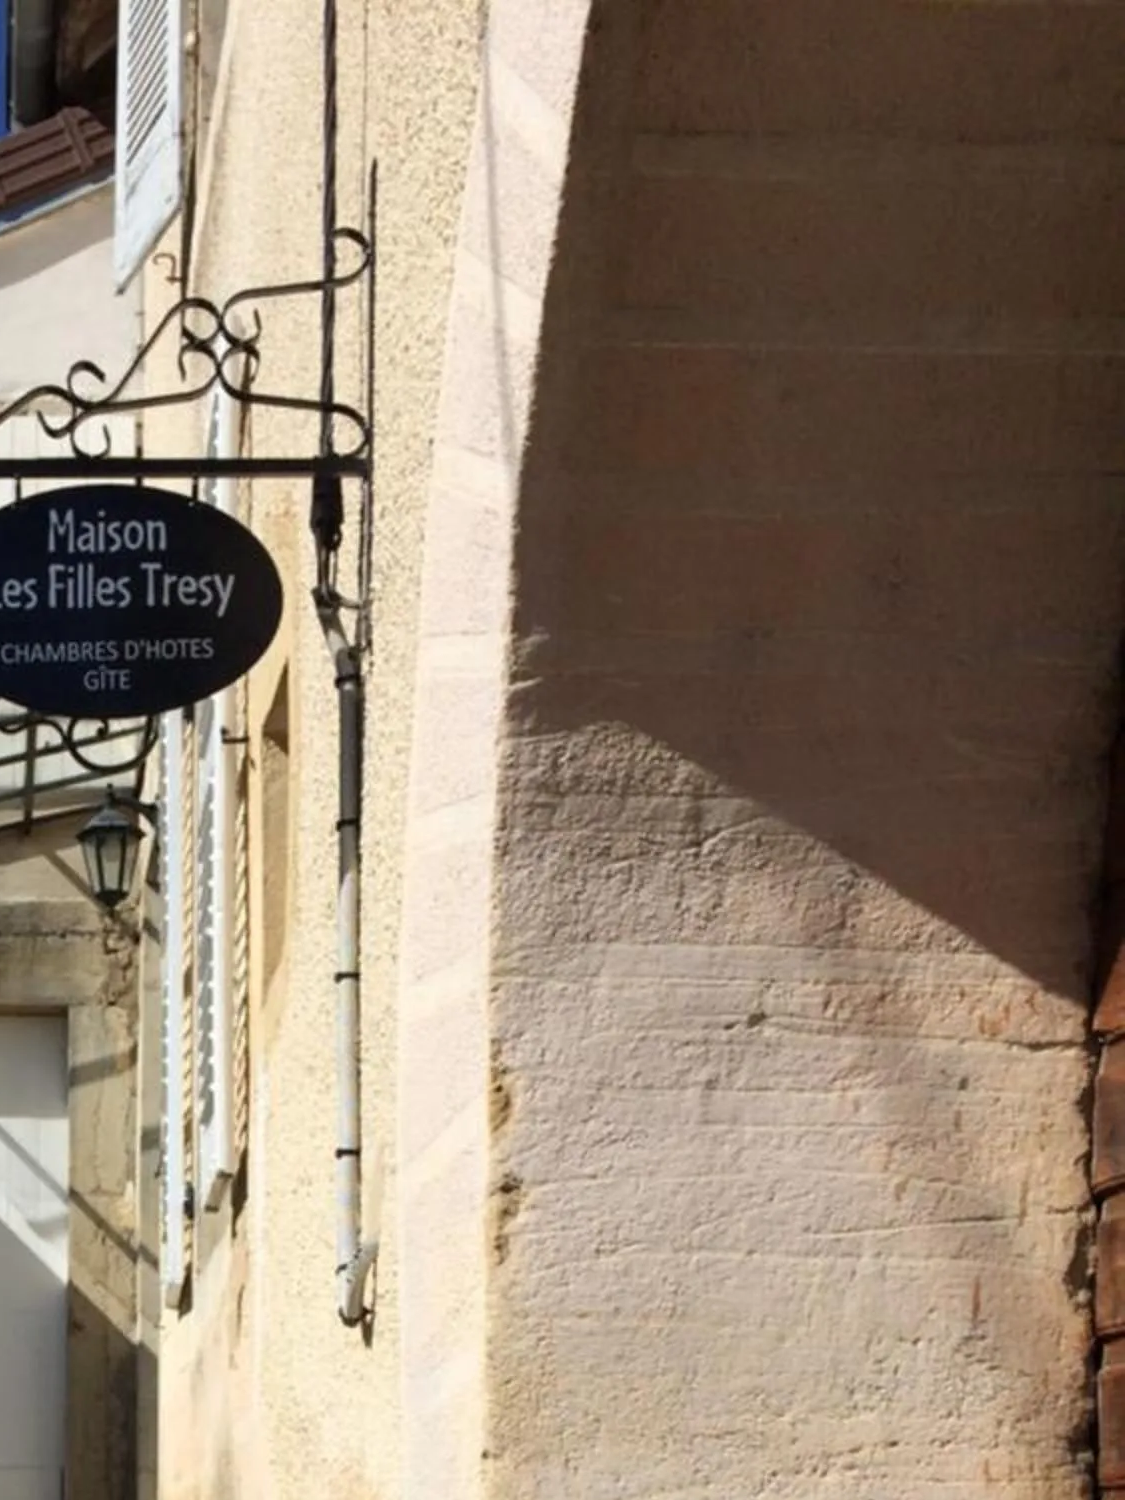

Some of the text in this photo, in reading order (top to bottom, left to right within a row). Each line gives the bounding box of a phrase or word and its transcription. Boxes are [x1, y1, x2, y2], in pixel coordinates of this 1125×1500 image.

[47, 508, 167, 554] Maison
[48, 563, 131, 608] Filles
[140, 562, 235, 617] Tresy
[0, 638, 214, 664] CHAMBRES D'HOTES
[83, 665, 131, 691] GÎTE
